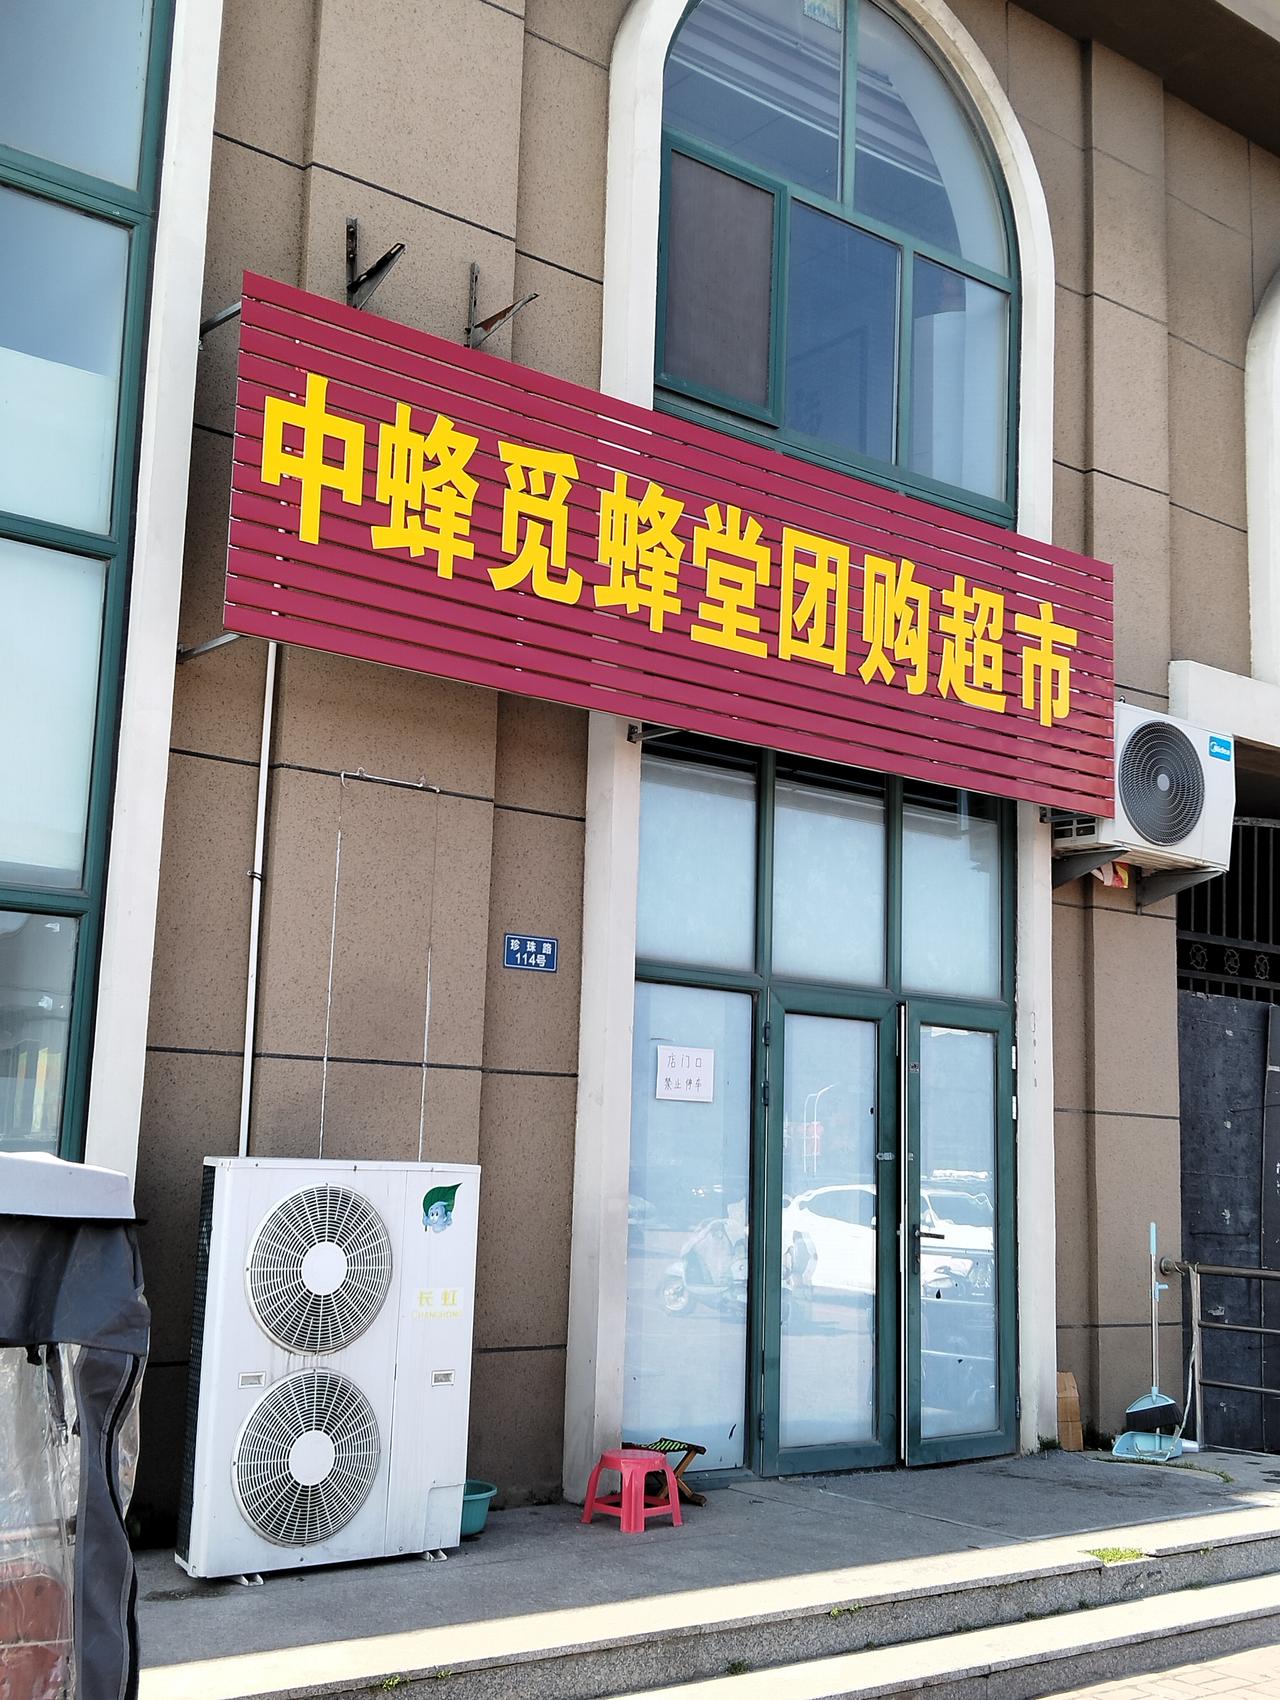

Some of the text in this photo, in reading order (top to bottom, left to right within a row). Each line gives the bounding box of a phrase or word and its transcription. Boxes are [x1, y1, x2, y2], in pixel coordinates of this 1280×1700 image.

[260, 372, 1078, 728] 中蜂觅蜂堂团购超市
[510, 939, 552, 955] 珍珠路
[515, 952, 546, 967] 114号
[667, 1052, 702, 1069] 店门口
[664, 1077, 702, 1092] 禁止停车
[418, 1289, 459, 1307] 长虹
